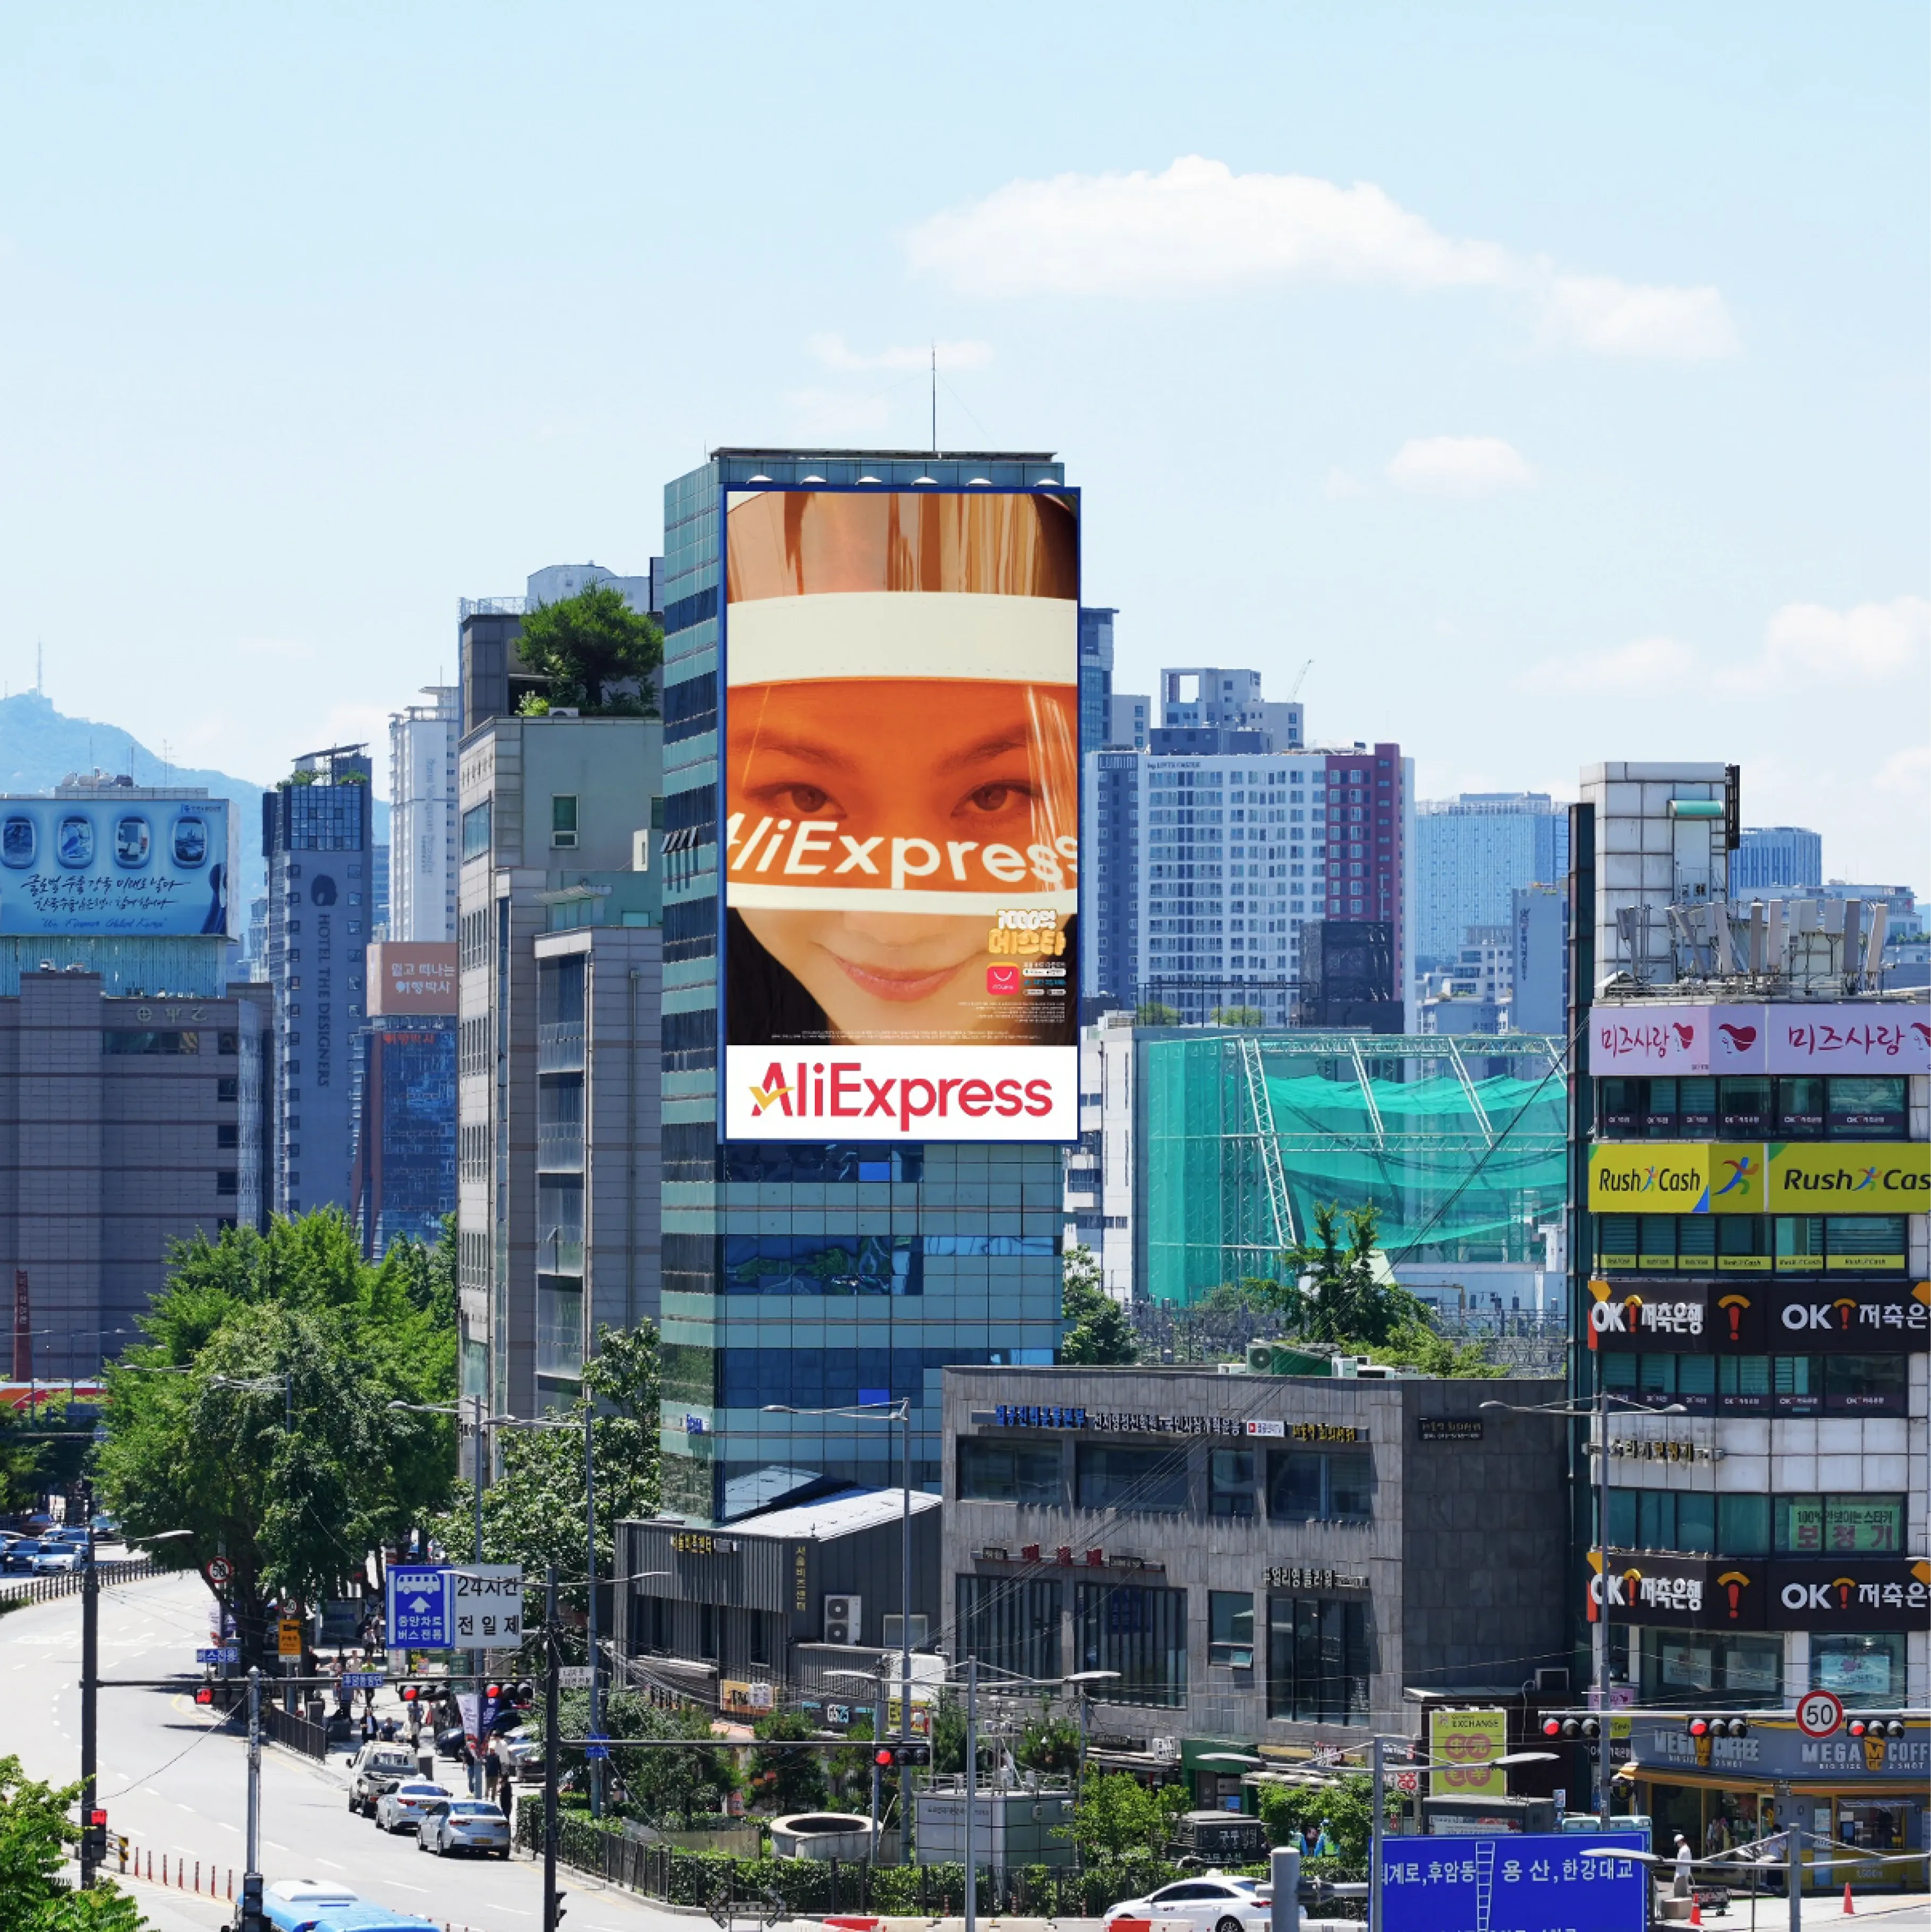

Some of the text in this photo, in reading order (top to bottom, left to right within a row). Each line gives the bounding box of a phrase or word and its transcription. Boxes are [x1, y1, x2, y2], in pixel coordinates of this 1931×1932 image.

[317, 913, 330, 1088] HOTEL THE DESIGNERS
[1601, 1023, 1670, 1058] 미즈사랑
[1788, 1023, 1906, 1056] 미즈사랑
[749, 1062, 1053, 1132] AliExpress
[1599, 1167, 1700, 1192] Rush Cash
[1783, 1168, 1852, 1190] Rush
[1593, 1301, 1704, 1335] OK 저축은행
[1781, 1302, 1931, 1329] OK 저축은
[457, 1575, 518, 1596] 24시간
[1590, 1573, 1704, 1611] OK 저축은행
[1781, 1582, 1931, 1609] OK 저축은
[457, 1614, 520, 1637] 전일제
[1806, 1705, 1833, 1726] 50
[1654, 1730, 1695, 1753] MEGA
[1802, 1742, 1931, 1762] MEGA COFF
